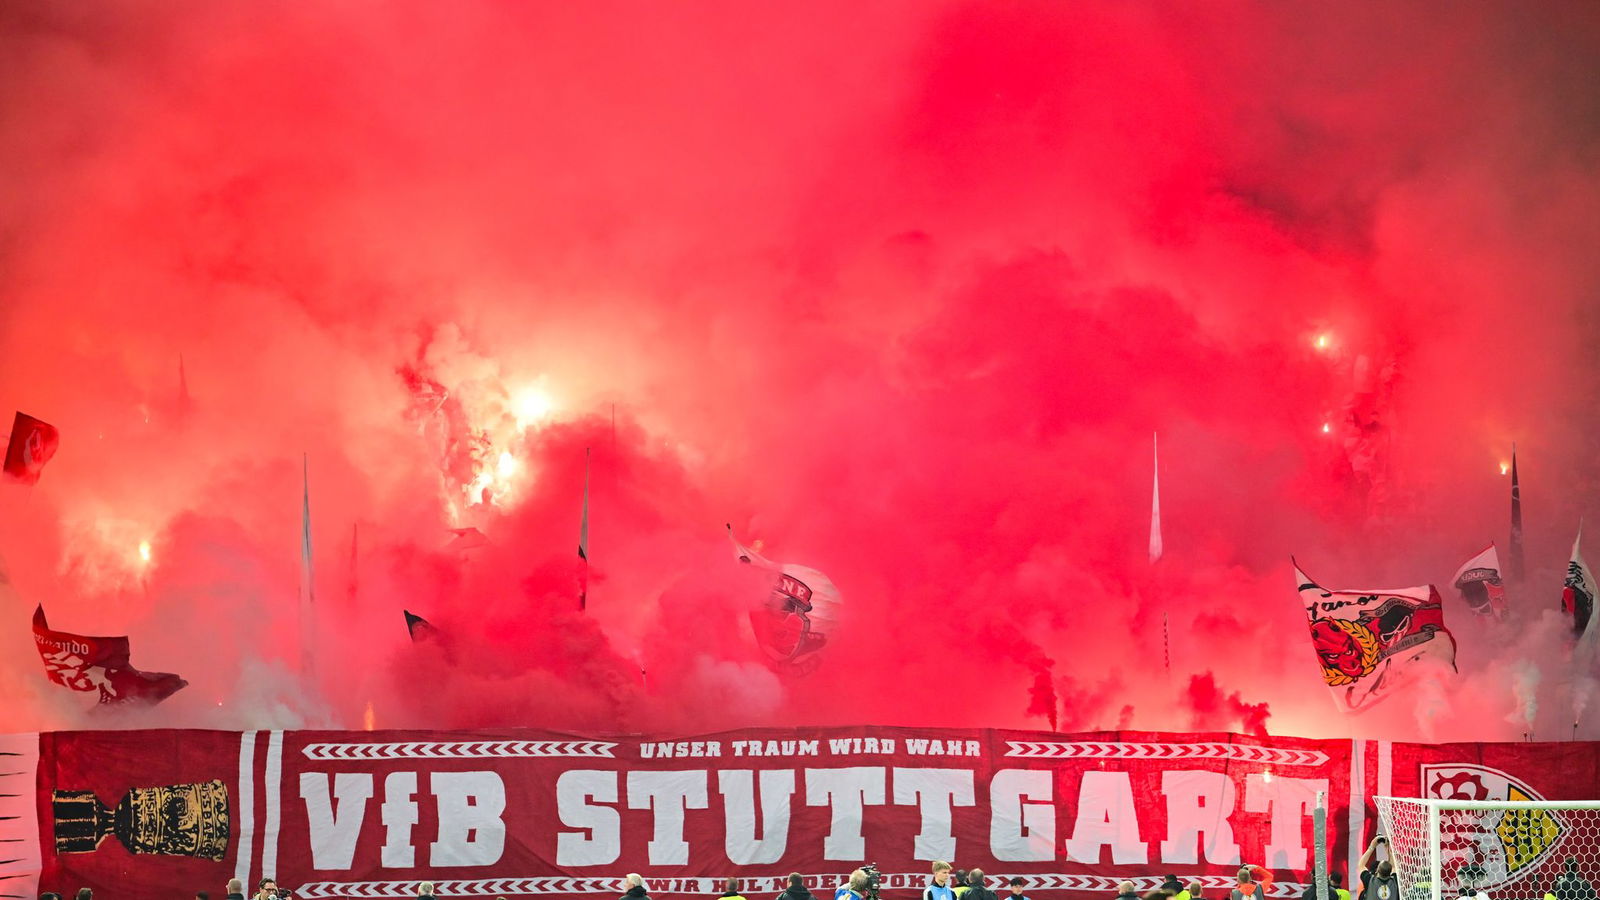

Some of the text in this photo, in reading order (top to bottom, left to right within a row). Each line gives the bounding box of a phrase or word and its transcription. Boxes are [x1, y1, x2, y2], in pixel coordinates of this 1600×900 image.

[640, 737, 981, 758] UNSER TRAUM WIRD WAHR
[300, 766, 1330, 870] VfB STUTTGART
[645, 879, 700, 893] WIR
